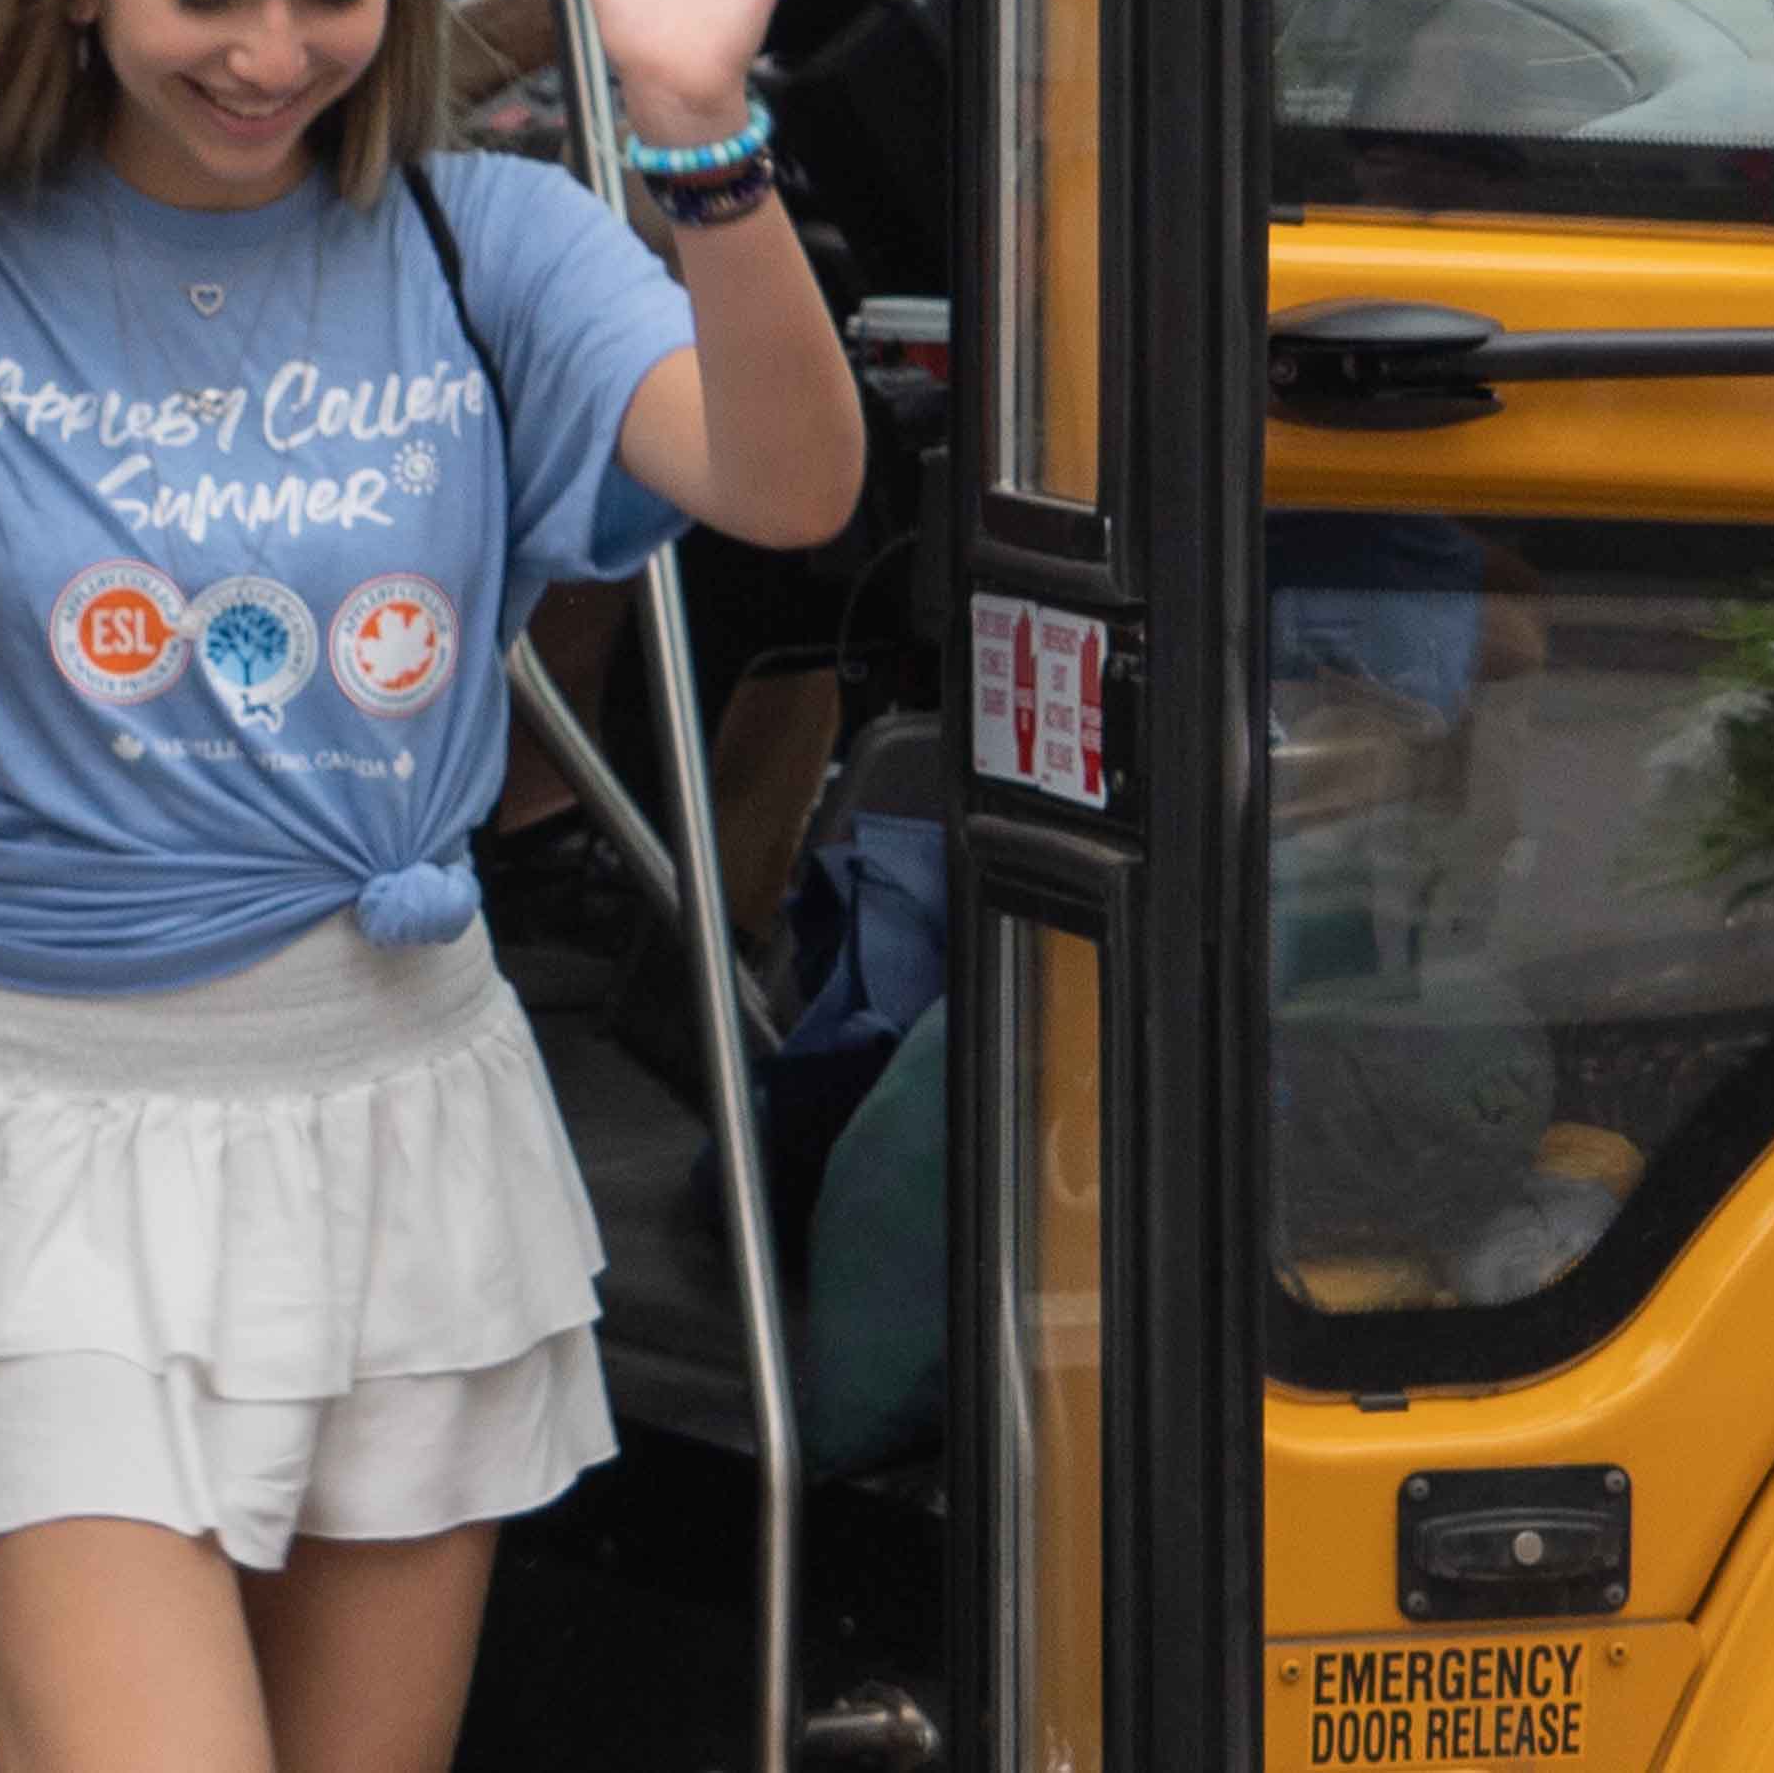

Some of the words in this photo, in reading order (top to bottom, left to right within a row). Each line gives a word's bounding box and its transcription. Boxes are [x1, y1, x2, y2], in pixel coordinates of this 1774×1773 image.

[91, 607, 156, 656] ESL
[1313, 1644, 1583, 1705] EMERGENCY
[1311, 1710, 1412, 1764] DOOR
[1426, 1703, 1582, 1760] RELEASE
